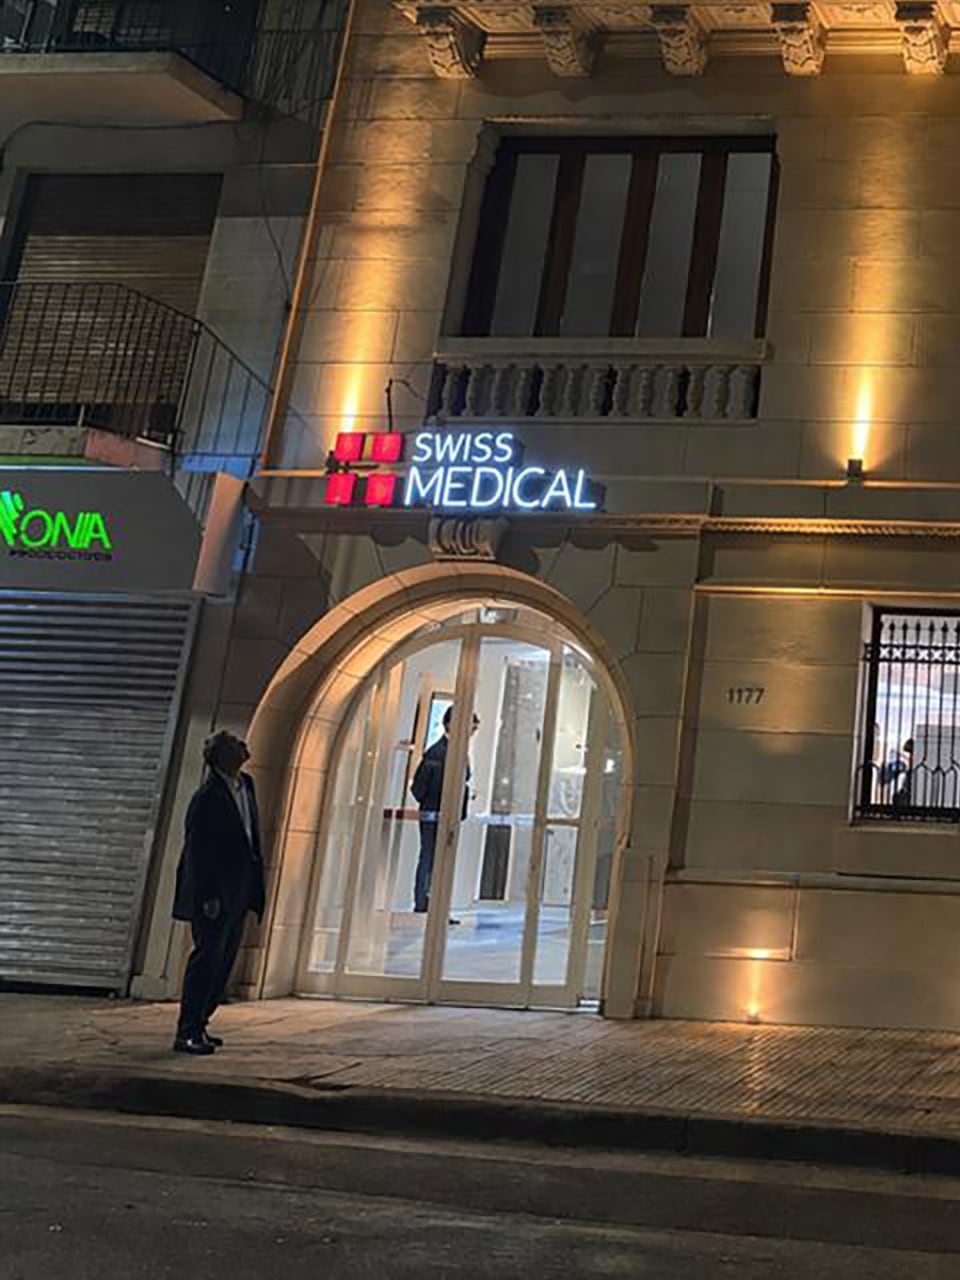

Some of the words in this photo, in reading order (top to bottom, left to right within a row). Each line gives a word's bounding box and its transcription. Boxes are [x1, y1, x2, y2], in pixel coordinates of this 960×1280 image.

[411, 432, 513, 463] SWISS
[403, 466, 598, 509] MEDICAL
[728, 687, 765, 705] 1177
